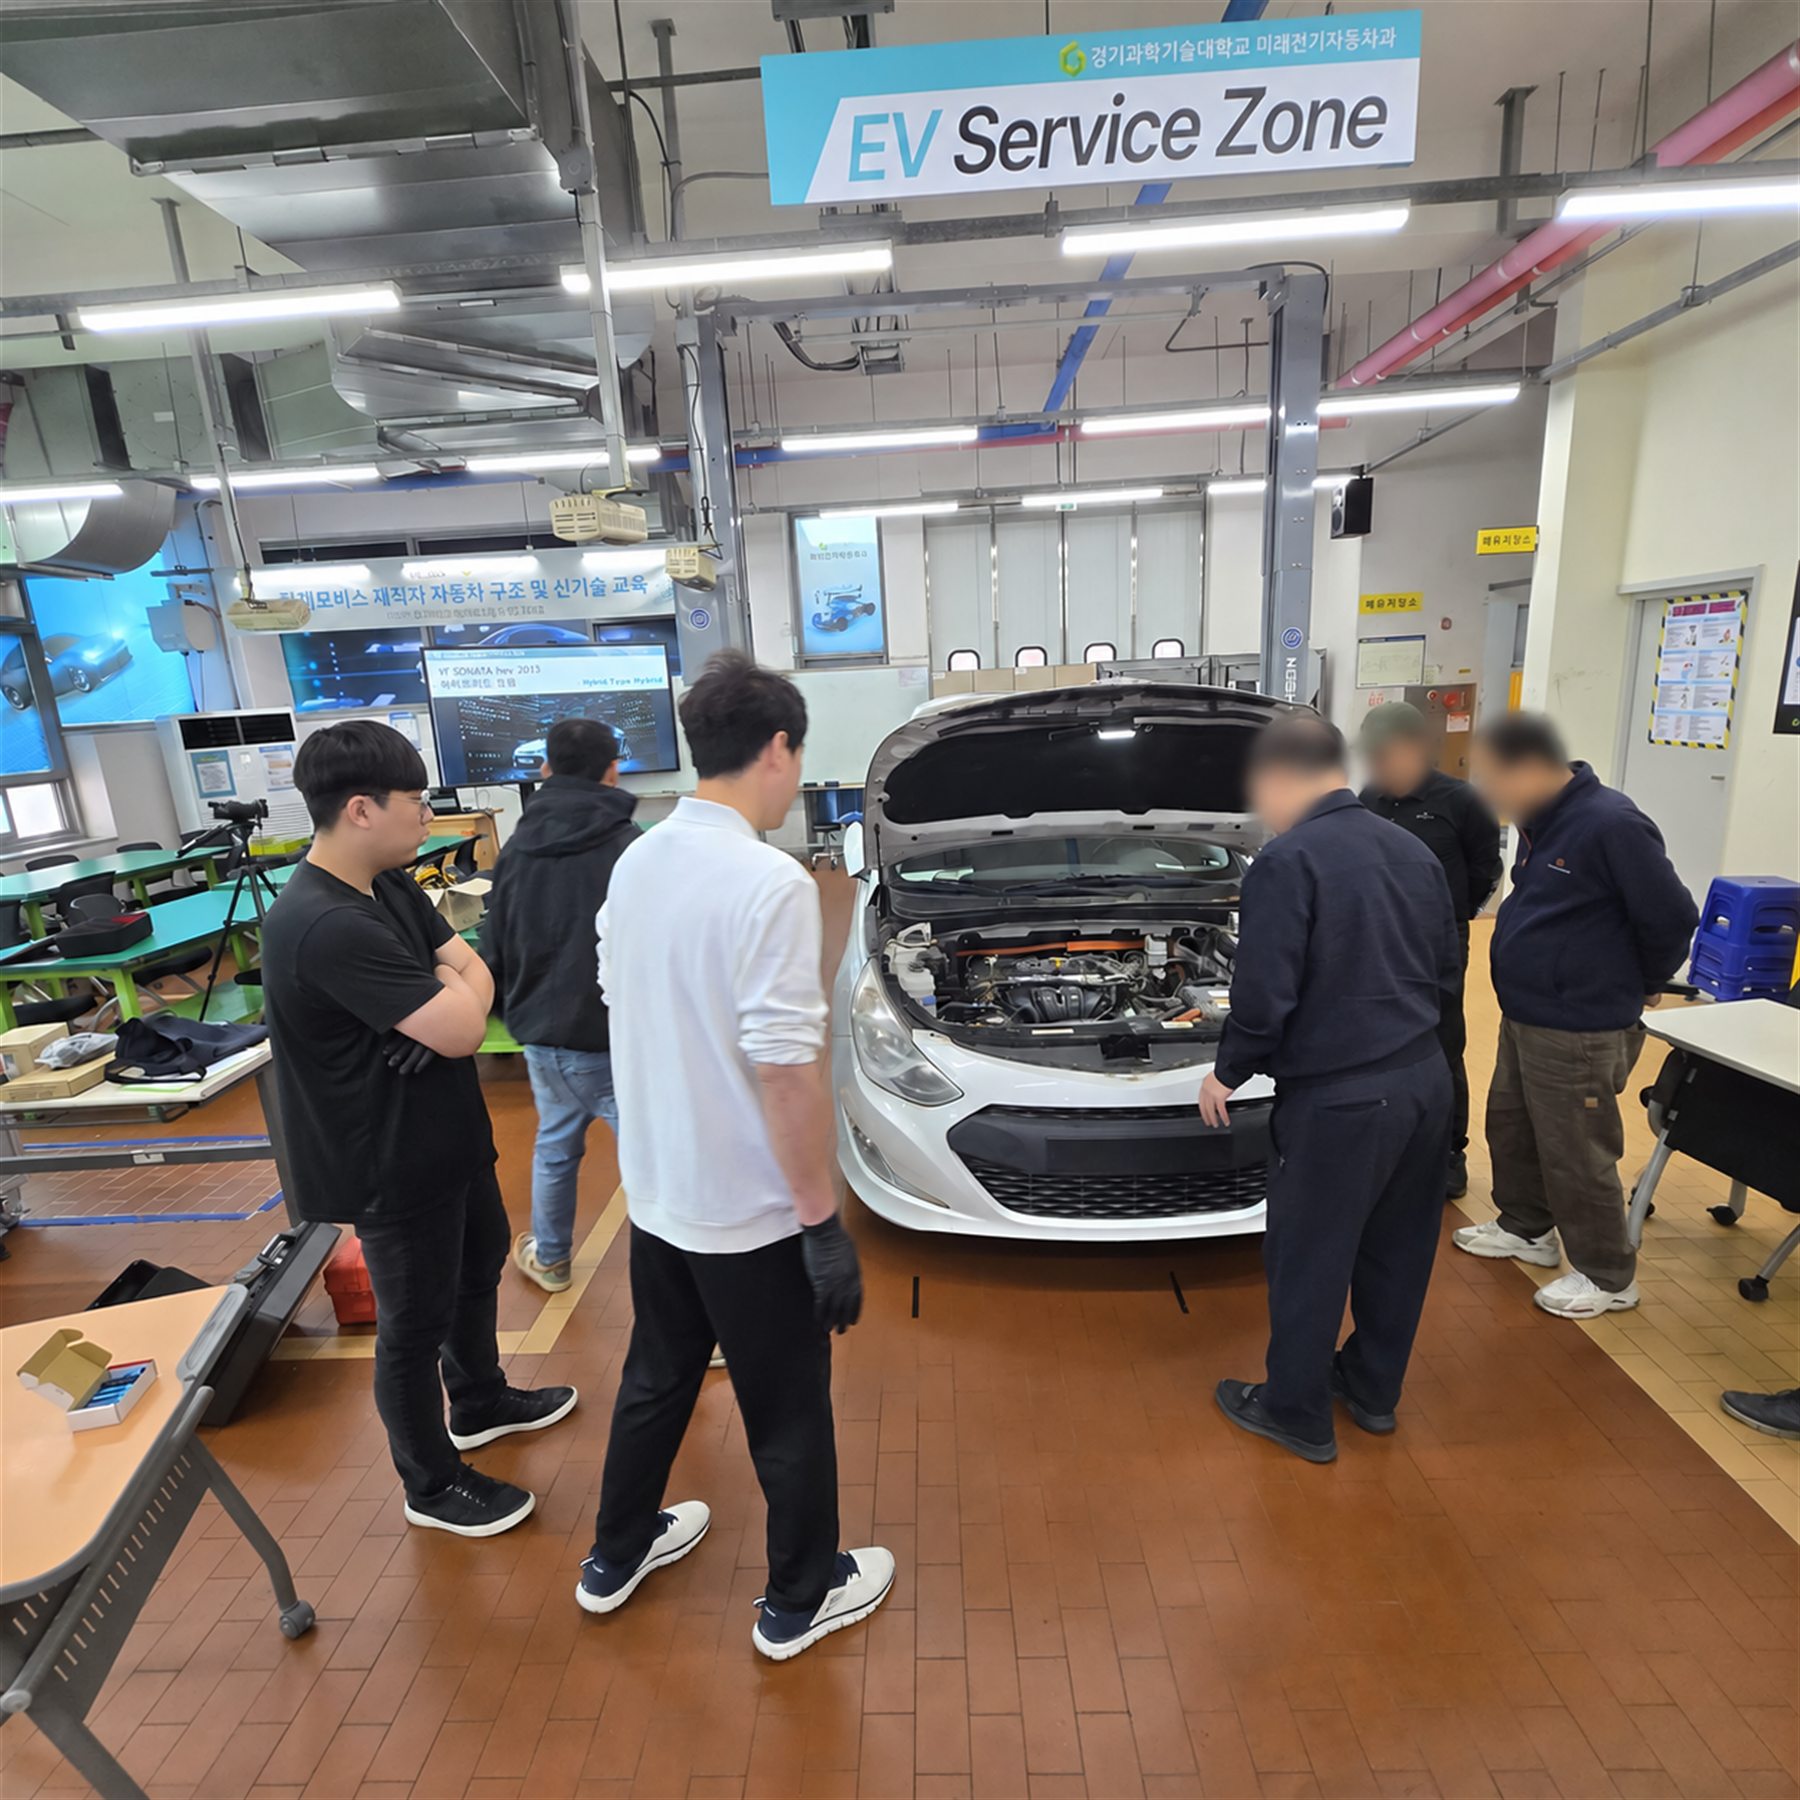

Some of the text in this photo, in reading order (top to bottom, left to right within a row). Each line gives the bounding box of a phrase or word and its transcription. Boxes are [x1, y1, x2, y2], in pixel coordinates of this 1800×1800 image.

[1091, 26, 1397, 68] 경기과학기술대학교 미래전기자동차과
[848, 86, 1389, 183] EV Service Zone
[373, 585, 426, 607] 재직자
[427, 582, 484, 604] 자동차
[490, 581, 526, 600] 구조
[530, 579, 549, 599] 및
[553, 577, 607, 599] 신기술
[612, 575, 648, 594] 교육
[453, 666, 493, 676] SONATA
